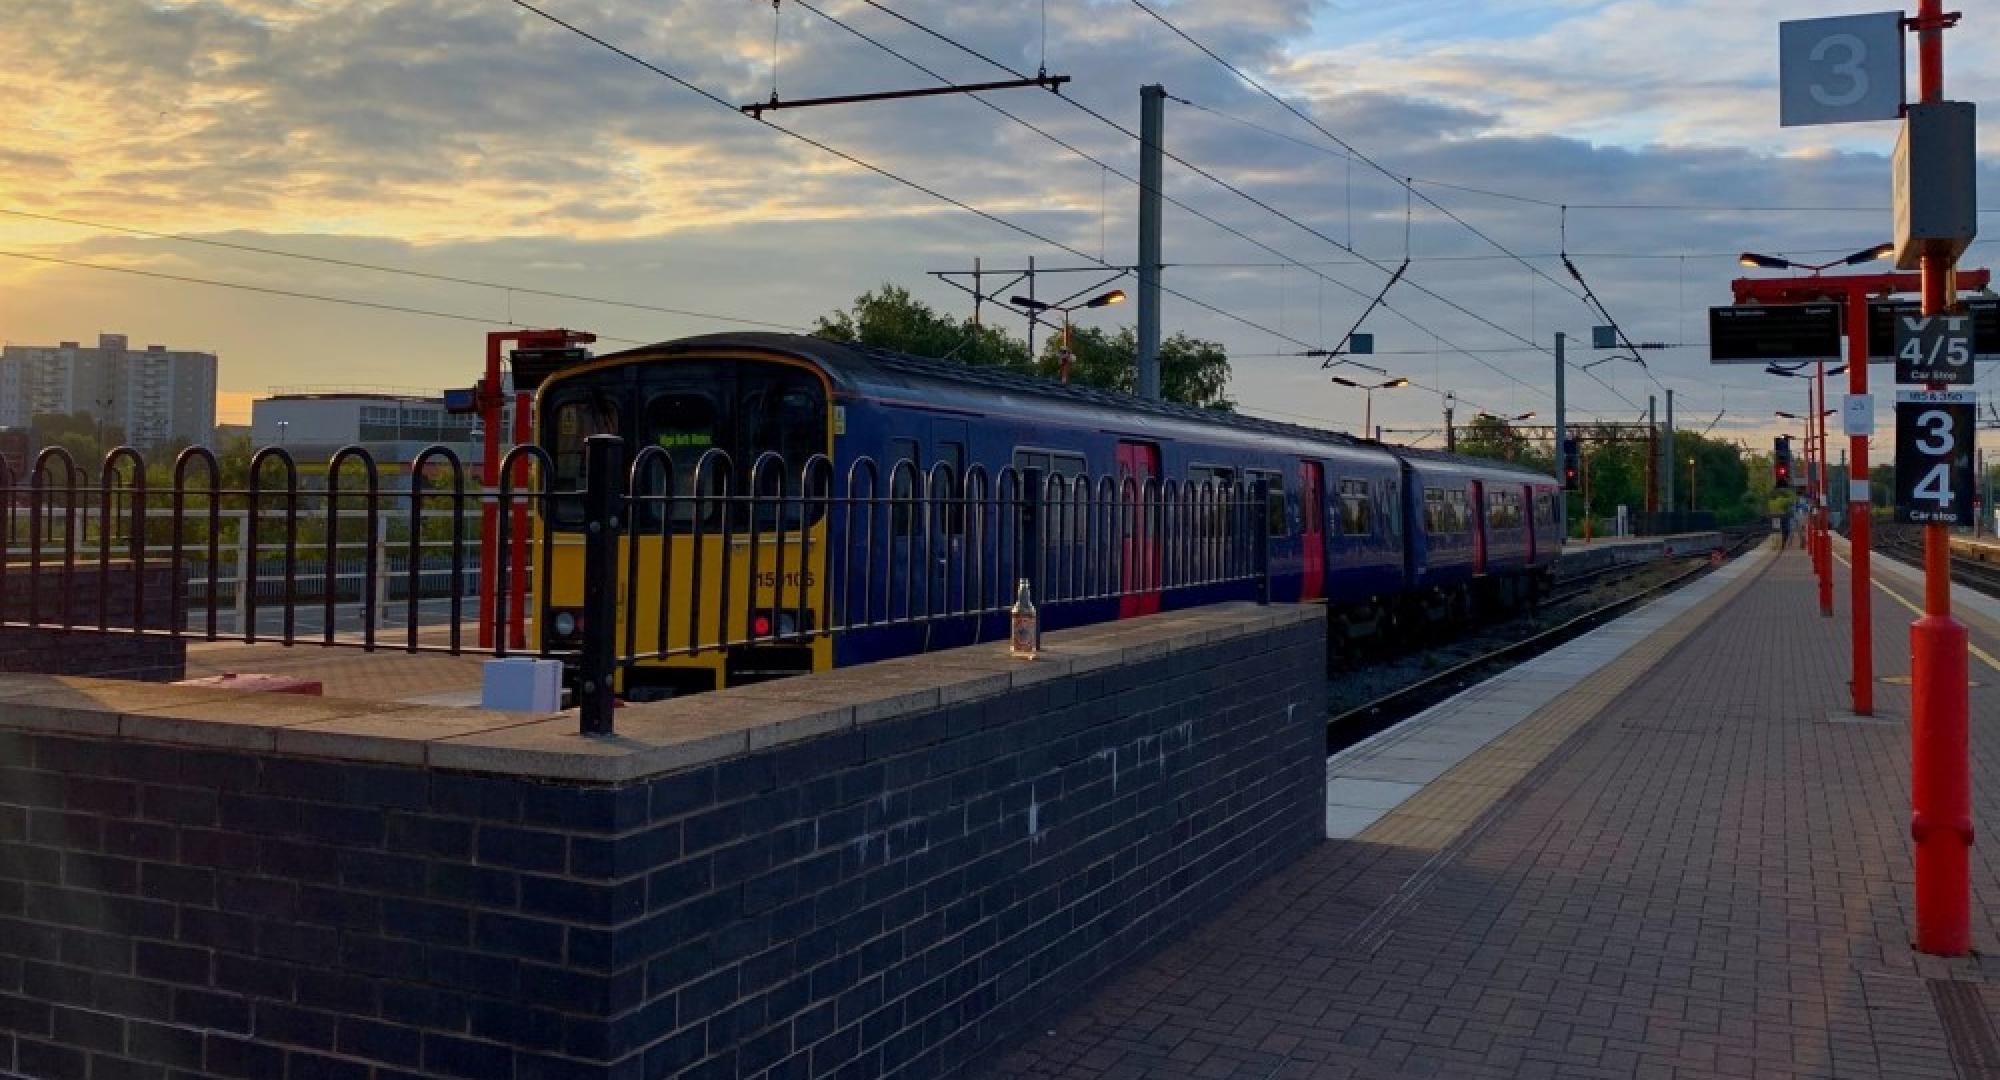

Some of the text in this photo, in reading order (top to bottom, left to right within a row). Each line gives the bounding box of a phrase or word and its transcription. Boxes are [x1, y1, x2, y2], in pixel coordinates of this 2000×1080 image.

[1808, 33, 1868, 106] 3
[1899, 335, 1969, 366] 4/5
[1911, 370, 1929, 379] Car
[1916, 410, 1954, 455] 3
[1913, 463, 1955, 507] 4
[1910, 510, 1930, 520] Car
